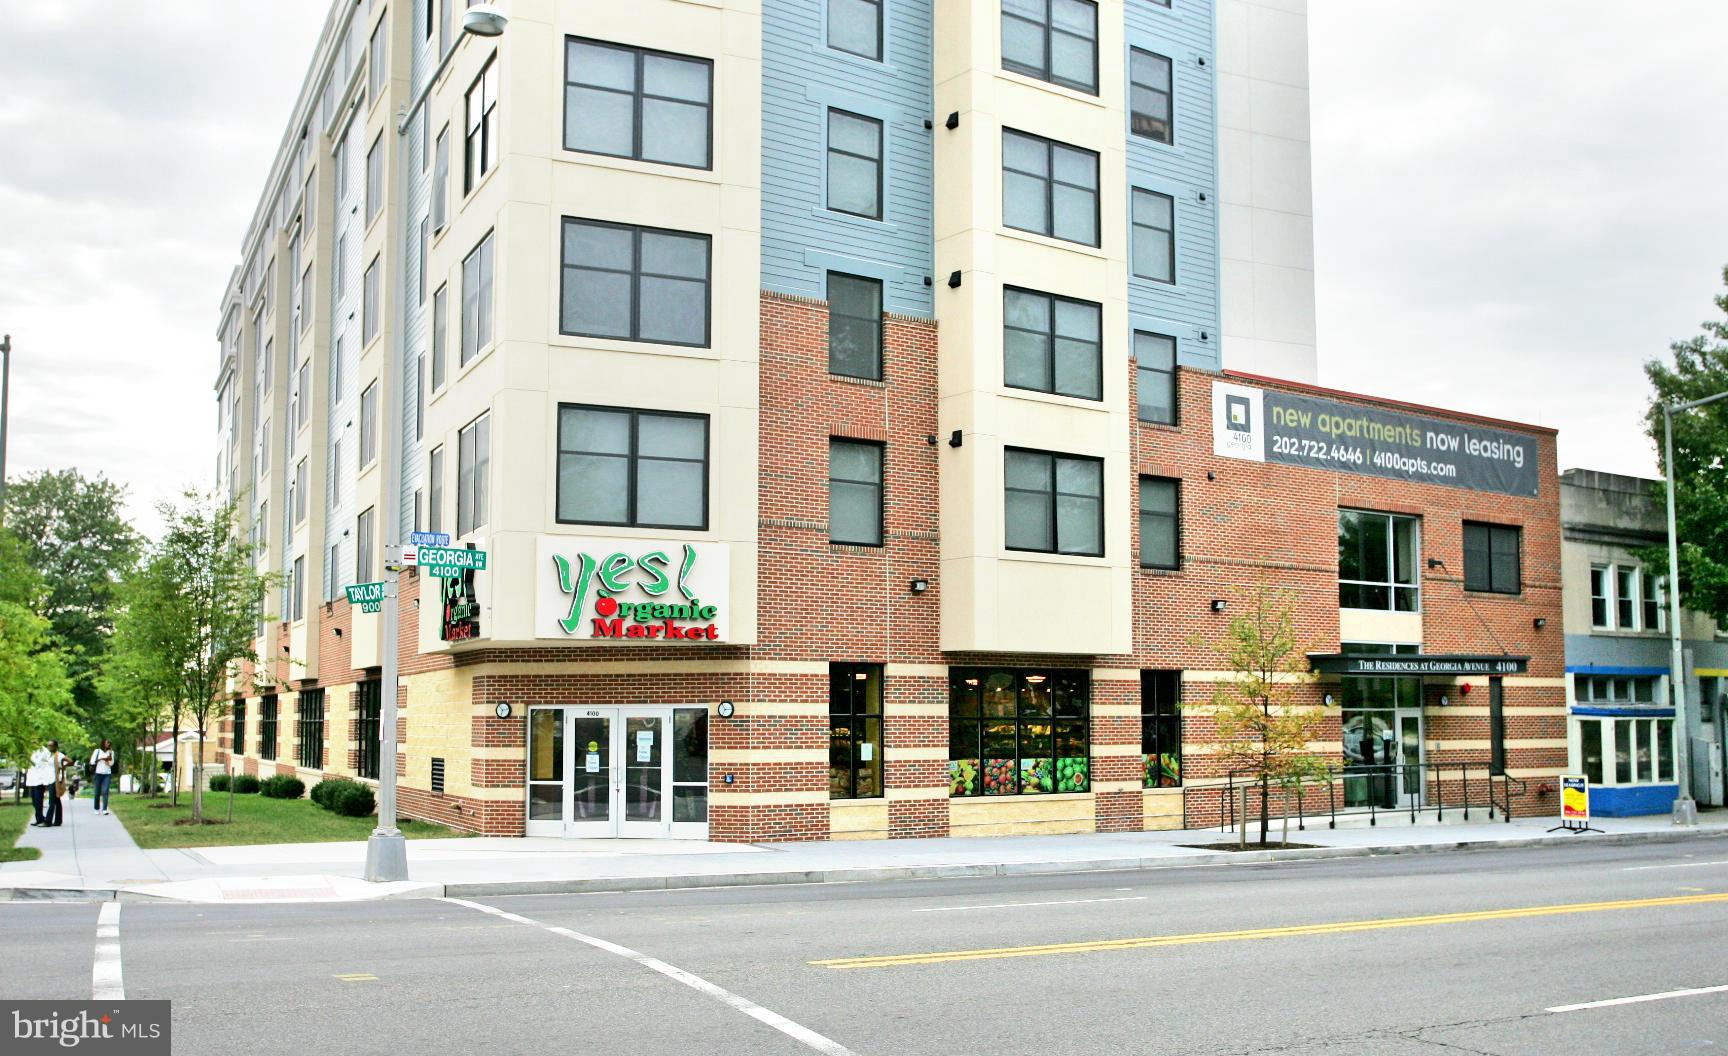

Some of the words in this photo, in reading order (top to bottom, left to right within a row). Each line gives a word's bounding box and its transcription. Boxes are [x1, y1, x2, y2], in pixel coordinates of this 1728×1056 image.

[1233, 432, 1252, 444] 4100
[1272, 405, 1312, 428] new
[1317, 413, 1421, 446] apartments
[1426, 431, 1460, 452] now
[1464, 433, 1524, 468] leasing
[1272, 435, 1362, 463] 202.722.4646
[1373, 450, 1456, 478] 4100apts.com
[420, 549, 473, 567] GEORGIA
[432, 566, 459, 577] 4100
[348, 584, 381, 602] TAYLOR
[552, 543, 697, 634] yes!
[362, 601, 381, 613] 900
[595, 592, 718, 622] Organic
[591, 617, 719, 641] Market
[1358, 659, 1374, 670] THE
[1375, 660, 1419, 671] RESIDENCES
[1419, 661, 1429, 671] AT
[1429, 660, 1462, 671] GEORGIA
[1463, 660, 1490, 671] AVENUE
[1496, 661, 1518, 672] 4100
